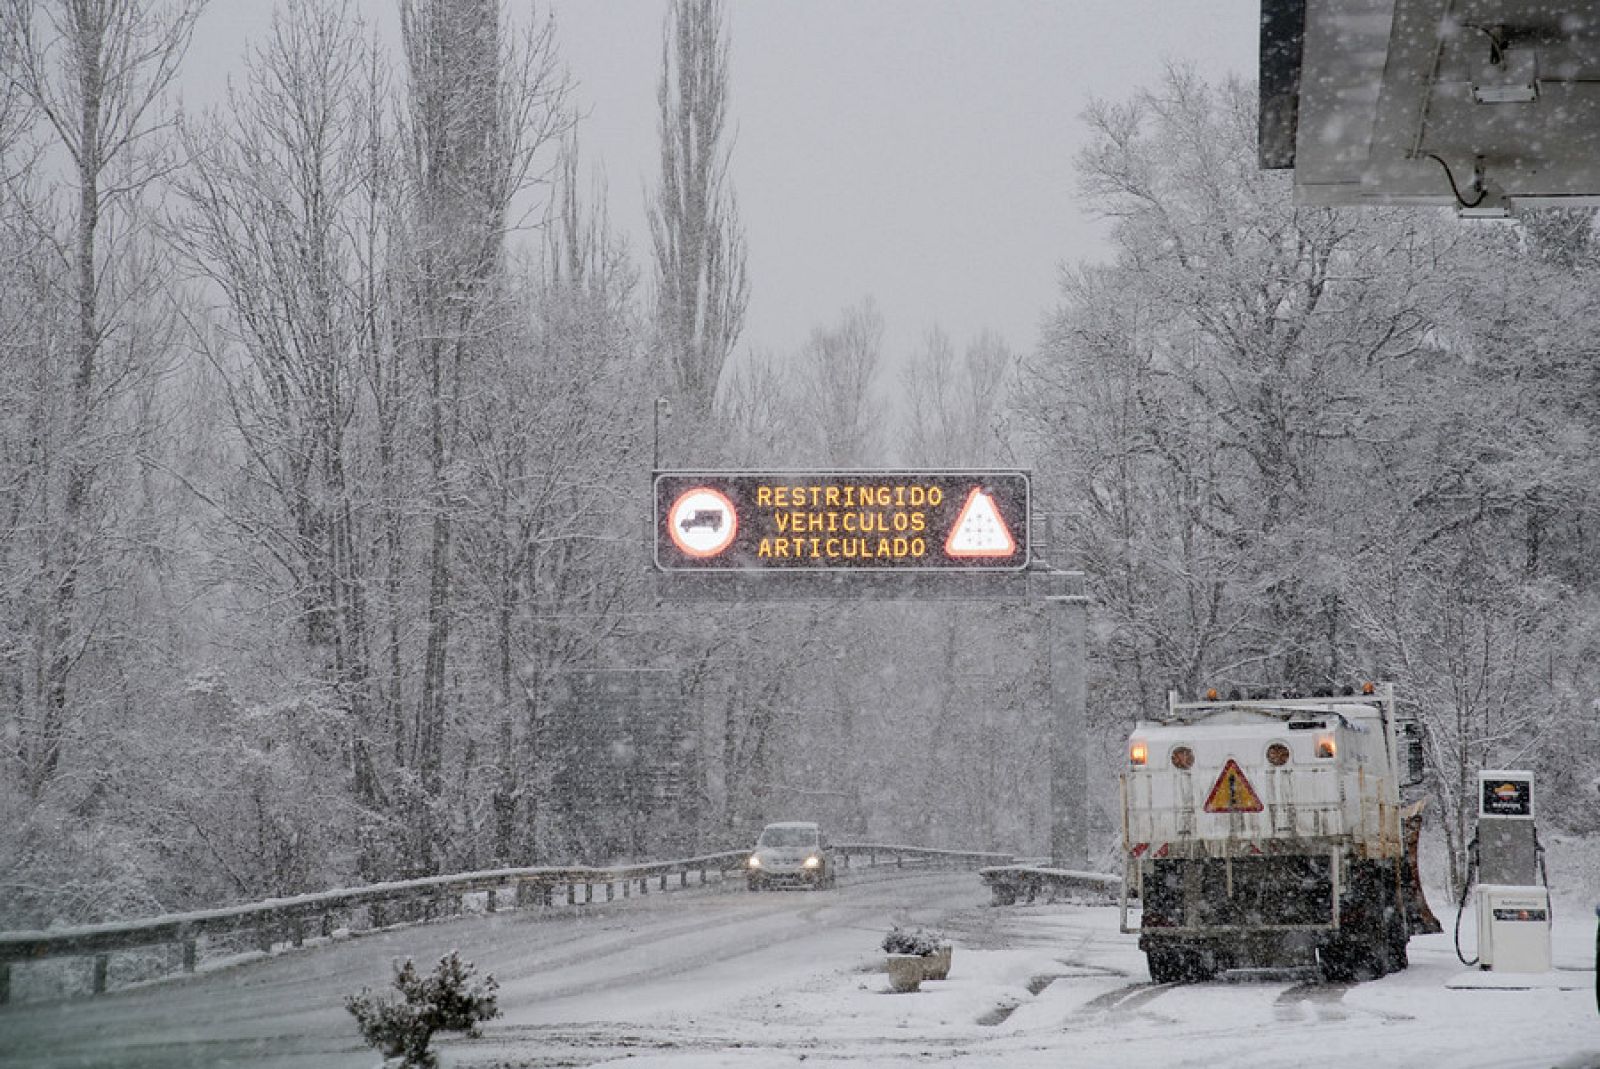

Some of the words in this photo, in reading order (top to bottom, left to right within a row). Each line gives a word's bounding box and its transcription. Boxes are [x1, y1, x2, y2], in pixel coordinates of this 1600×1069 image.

[757, 486, 943, 506] RESTRINGIDO
[774, 511, 926, 531] VEHICULOS
[757, 536, 926, 556] ARTICULADO
